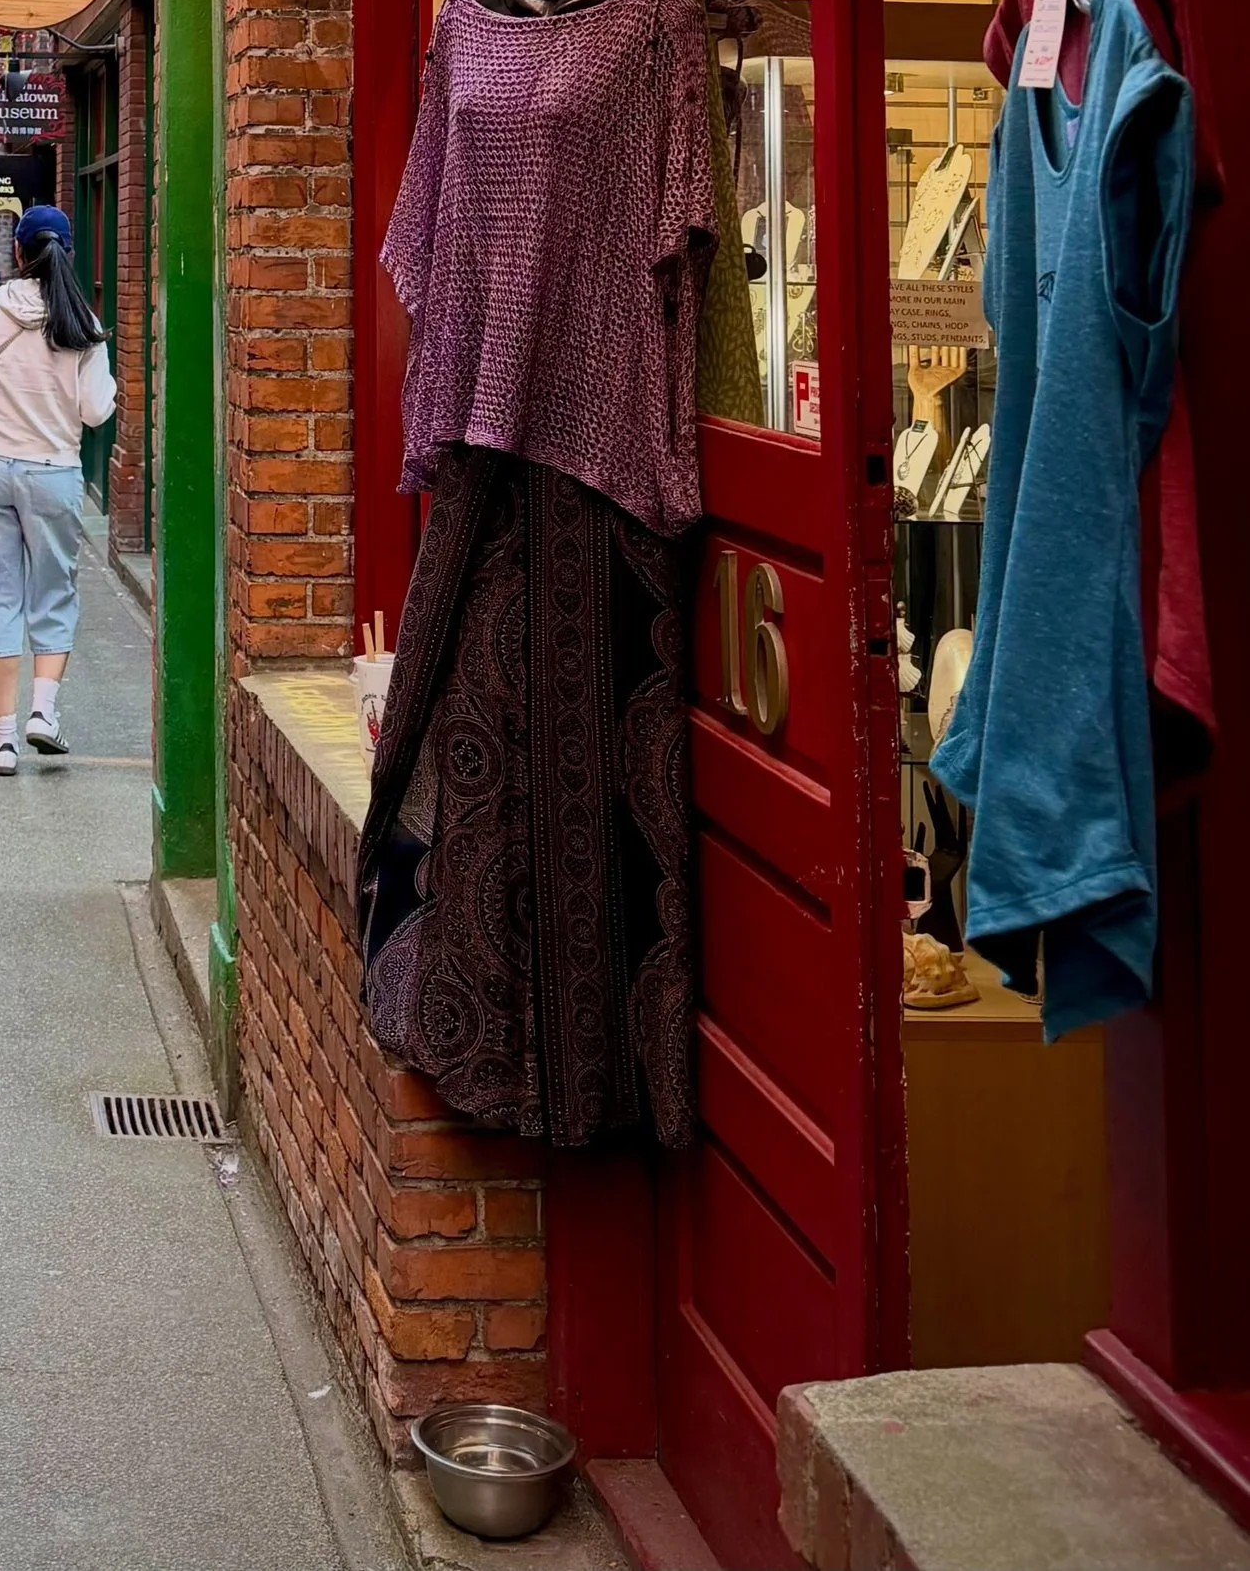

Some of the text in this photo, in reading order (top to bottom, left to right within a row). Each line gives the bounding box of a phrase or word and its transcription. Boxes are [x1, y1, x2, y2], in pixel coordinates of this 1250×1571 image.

[921, 284, 945, 293] THESE
[948, 285, 974, 294] STYLES
[913, 296, 921, 304] IN
[923, 296, 942, 305] OUR
[943, 297, 965, 305] MAIN
[944, 322, 969, 330] HOOP
[714, 550, 790, 735] 16
